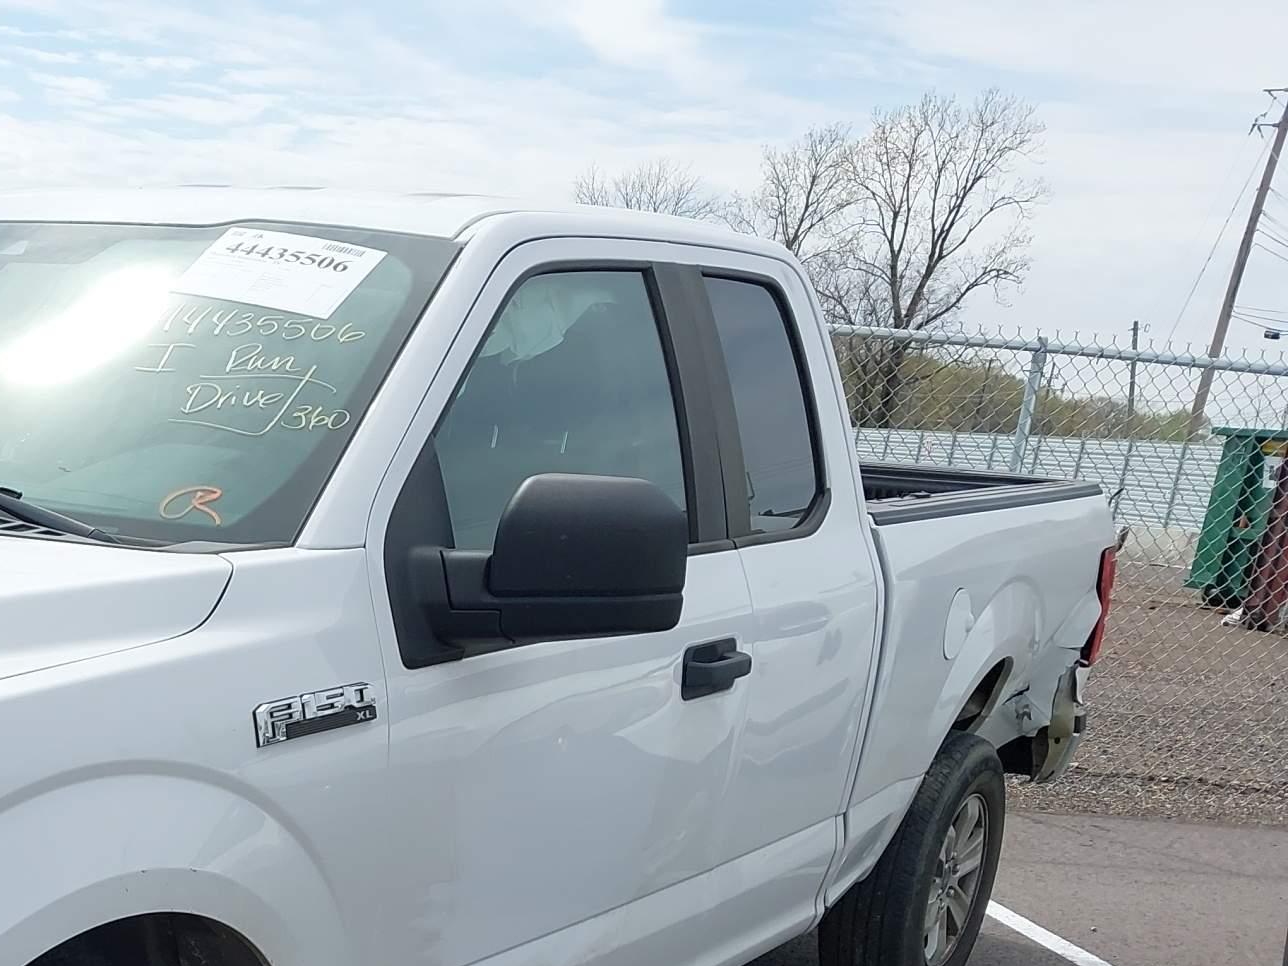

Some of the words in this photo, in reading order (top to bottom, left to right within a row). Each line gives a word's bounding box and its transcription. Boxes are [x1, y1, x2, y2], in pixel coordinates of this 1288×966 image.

[226, 242, 352, 272] 44435506
[225, 343, 300, 373] Run
[281, 405, 350, 430] 360
[356, 710, 373, 721] XL
